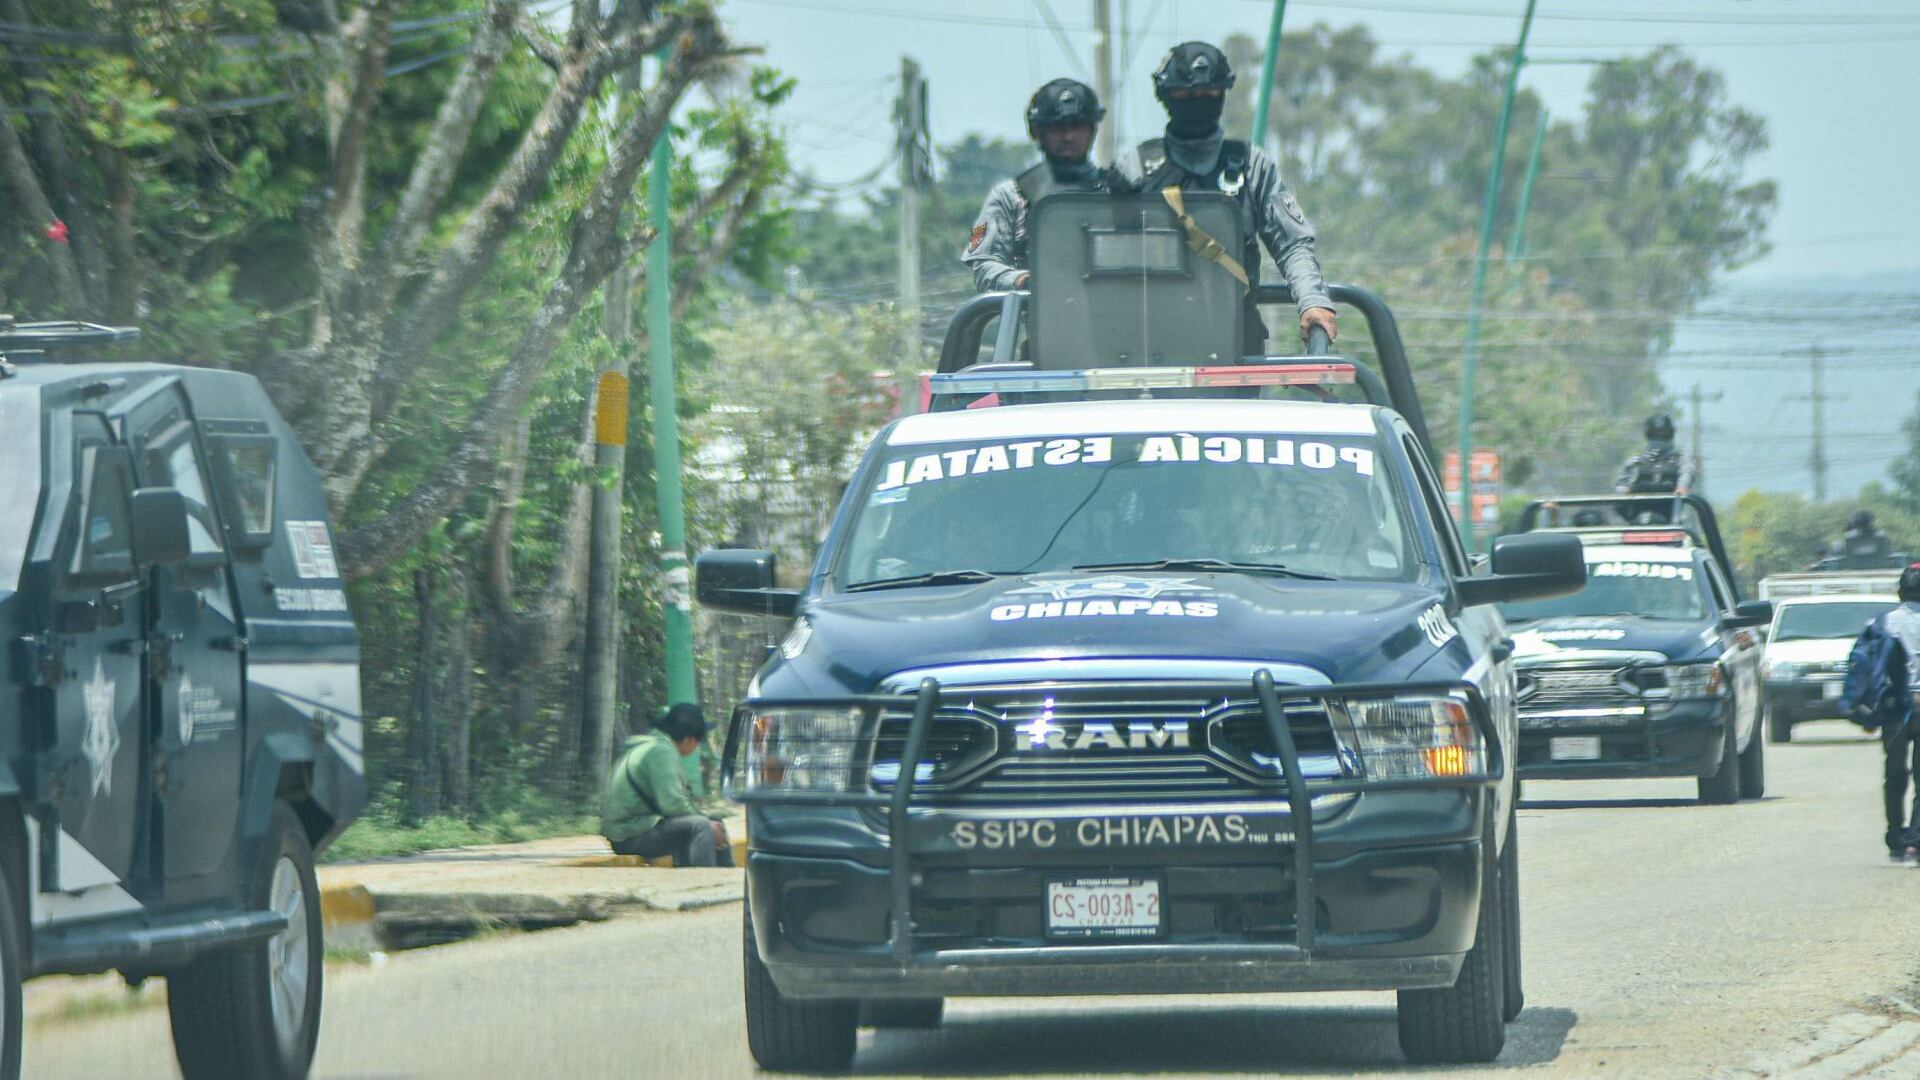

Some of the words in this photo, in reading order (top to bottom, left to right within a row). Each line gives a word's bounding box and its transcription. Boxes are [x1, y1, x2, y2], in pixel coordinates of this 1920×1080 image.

[990, 600, 1219, 622] CHIAPAS
[1014, 720, 1190, 751] RAM
[953, 818, 1057, 849] SSPC
[1076, 814, 1246, 846] CHIAPAS
[1052, 893, 1160, 919] CS-003A-2
